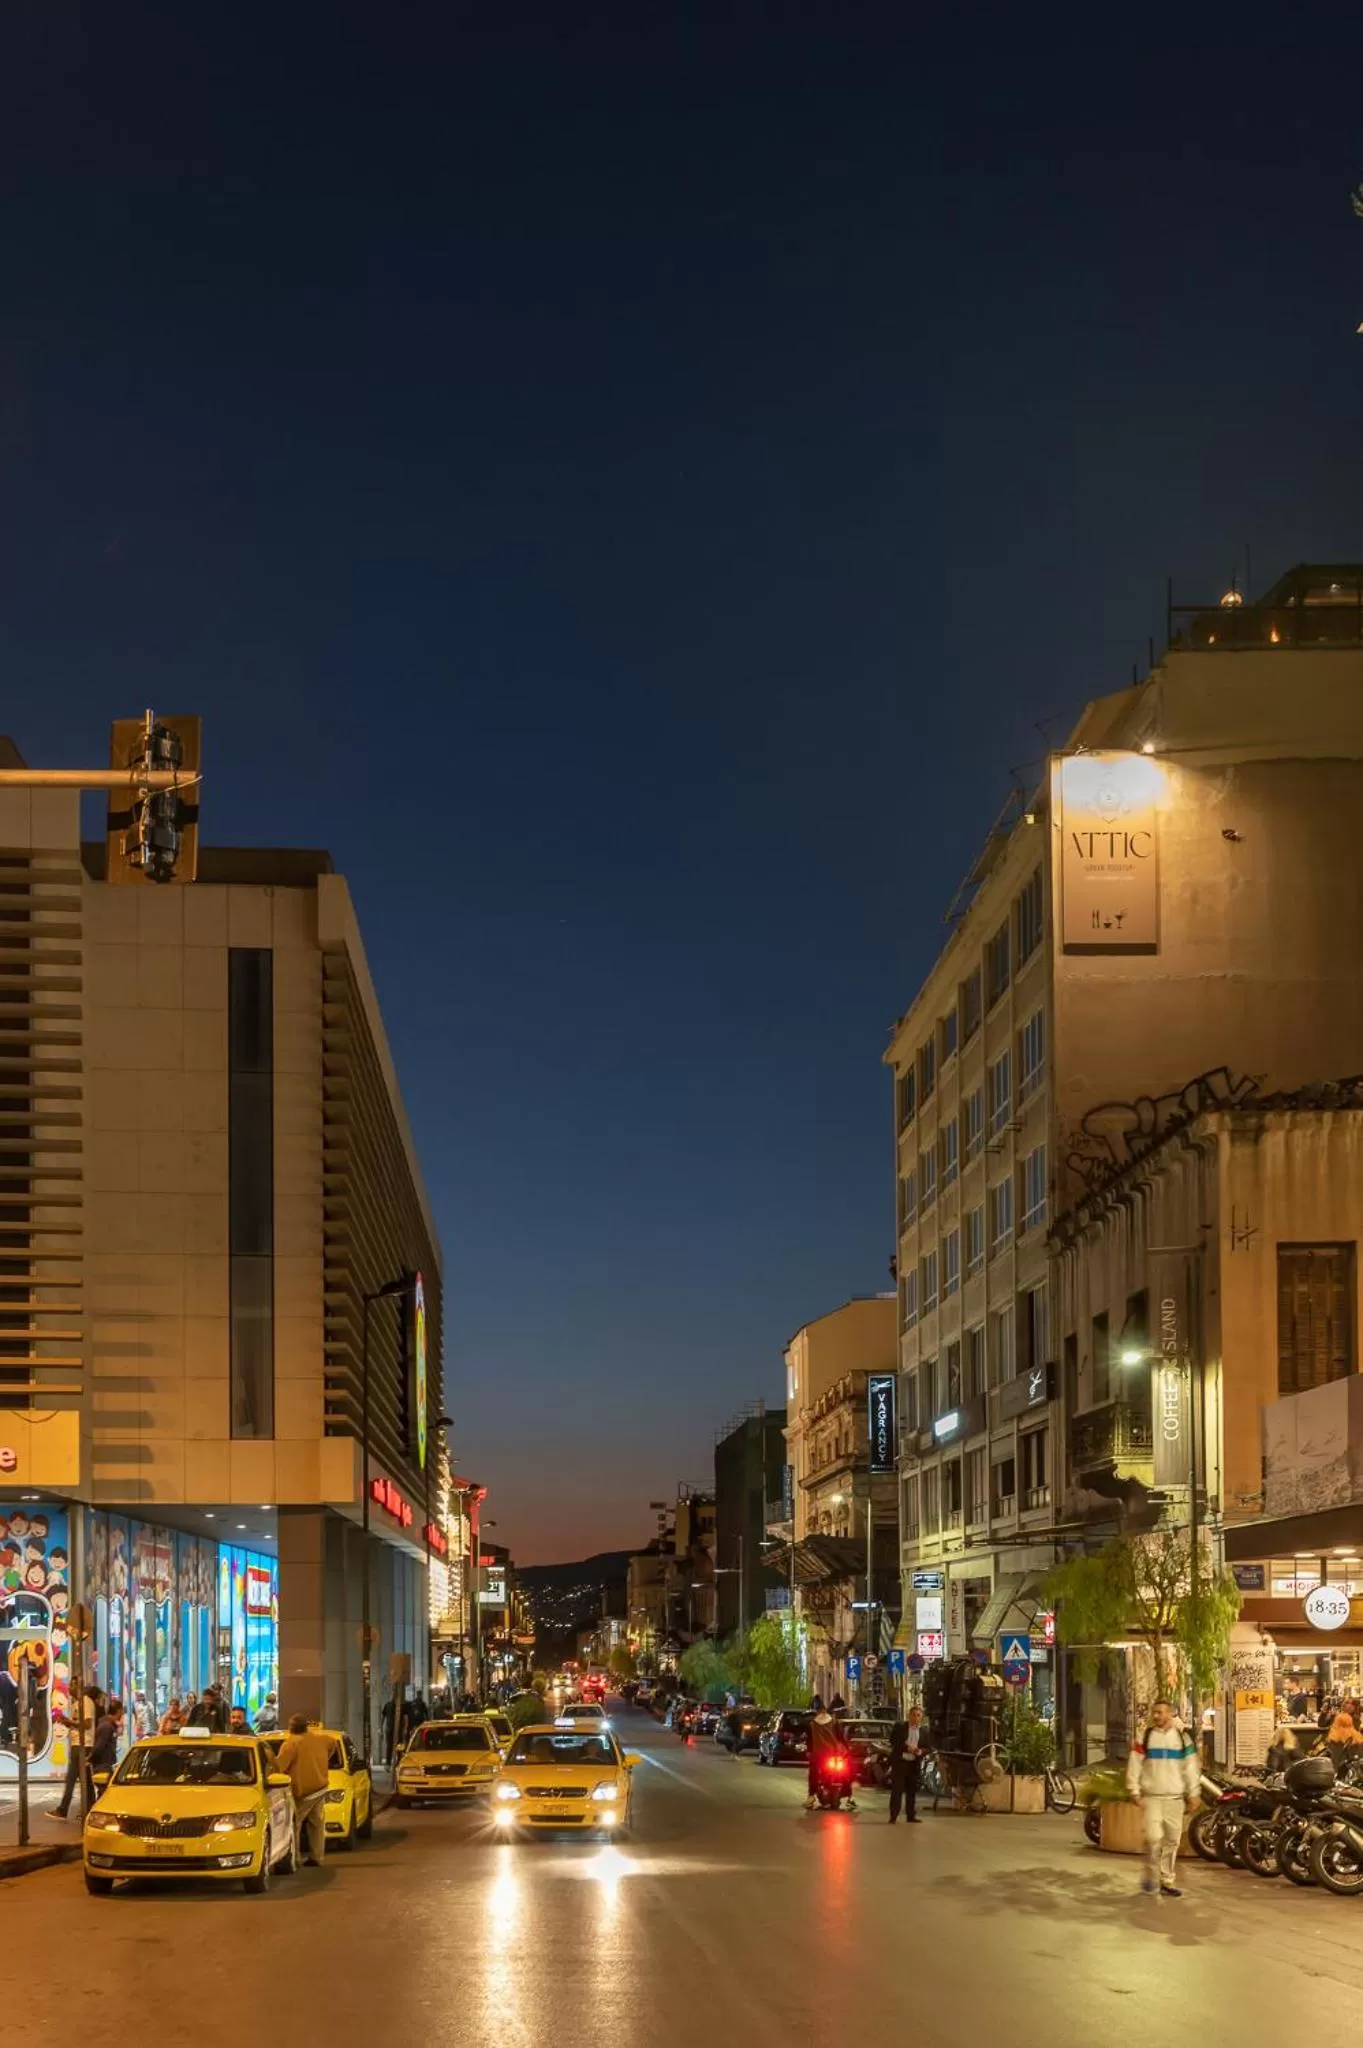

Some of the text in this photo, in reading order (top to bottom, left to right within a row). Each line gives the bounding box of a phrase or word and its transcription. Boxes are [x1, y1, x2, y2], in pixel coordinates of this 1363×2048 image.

[1072, 832, 1152, 859] ATTIC
[1161, 1298, 1177, 1356] SLAND
[877, 1393, 887, 1461] VAGRANCY
[850, 1658, 858, 1668] P
[891, 1652, 900, 1663] P
